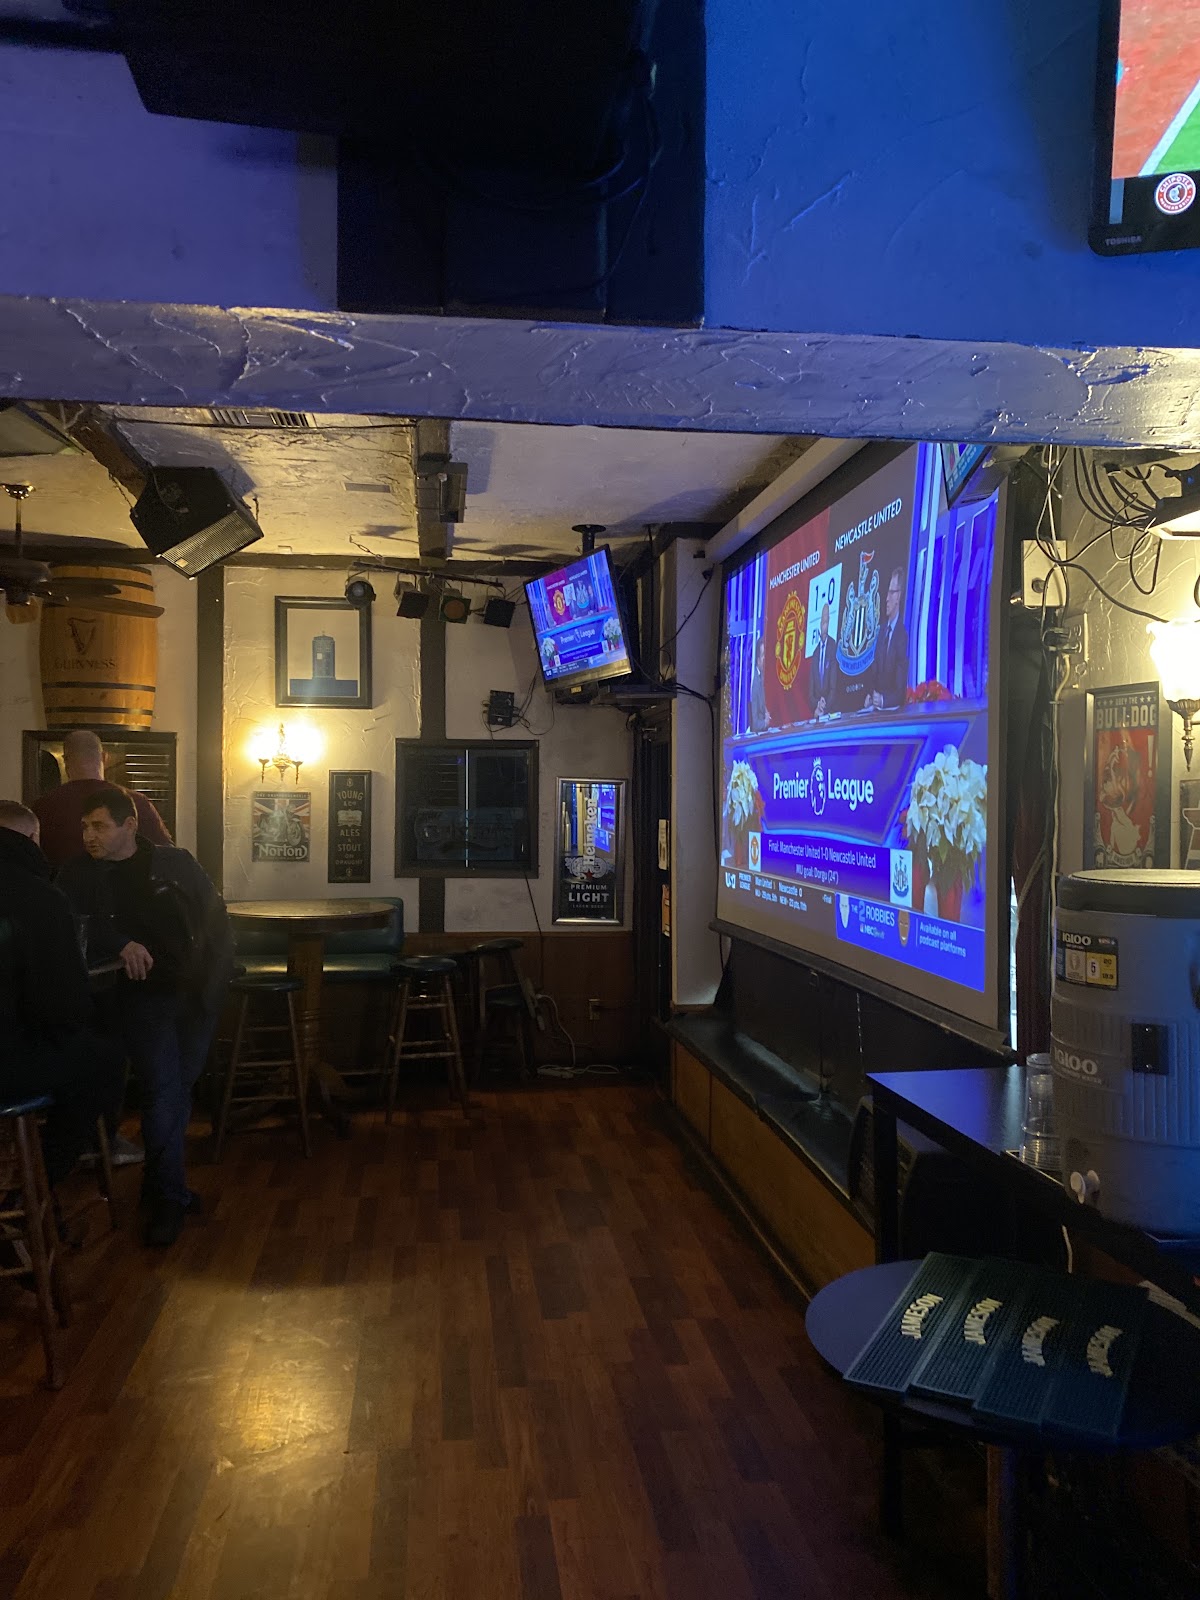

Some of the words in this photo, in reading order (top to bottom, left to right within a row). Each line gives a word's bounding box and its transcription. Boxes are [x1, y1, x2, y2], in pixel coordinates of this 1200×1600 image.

[1159, 176, 1192, 192] CHIPOTLE
[1105, 235, 1142, 246] TOSHIBA
[834, 515, 873, 554] NEWCASTLE
[873, 497, 902, 529] UNITED
[769, 561, 800, 590] MANCHESTER
[800, 550, 821, 574] UNITED
[560, 633, 574, 644] Premier
[580, 628, 596, 638] League
[53, 657, 116, 671] GUINNESS
[1128, 696, 1138, 704] THE
[1096, 704, 1157, 729] BULLDOG
[336, 790, 364, 801] YOUNG
[773, 771, 809, 800] Premier
[827, 768, 874, 811] League
[339, 829, 360, 837] ALES
[583, 798, 598, 866] Heineken
[254, 842, 308, 860] Norton
[337, 843, 362, 852] STOUT
[779, 841, 805, 857] Manchester
[805, 844, 821, 860] United
[829, 847, 856, 866] Newcastle
[856, 851, 877, 869] United
[814, 867, 828, 882] Dorgu
[568, 892, 610, 903] LIGHT
[859, 900, 866, 923] 2
[865, 905, 895, 927] ROBBIES
[919, 921, 942, 938] Available
[942, 929, 950, 939] on
[1062, 932, 1092, 946] IGLOO
[919, 934, 939, 949] podcast
[939, 939, 967, 958] platforms
[1090, 961, 1096, 974] 5
[1053, 1045, 1098, 1075] IGLOO
[901, 1292, 944, 1340] JAMESON
[963, 1297, 1004, 1345] JAMESON
